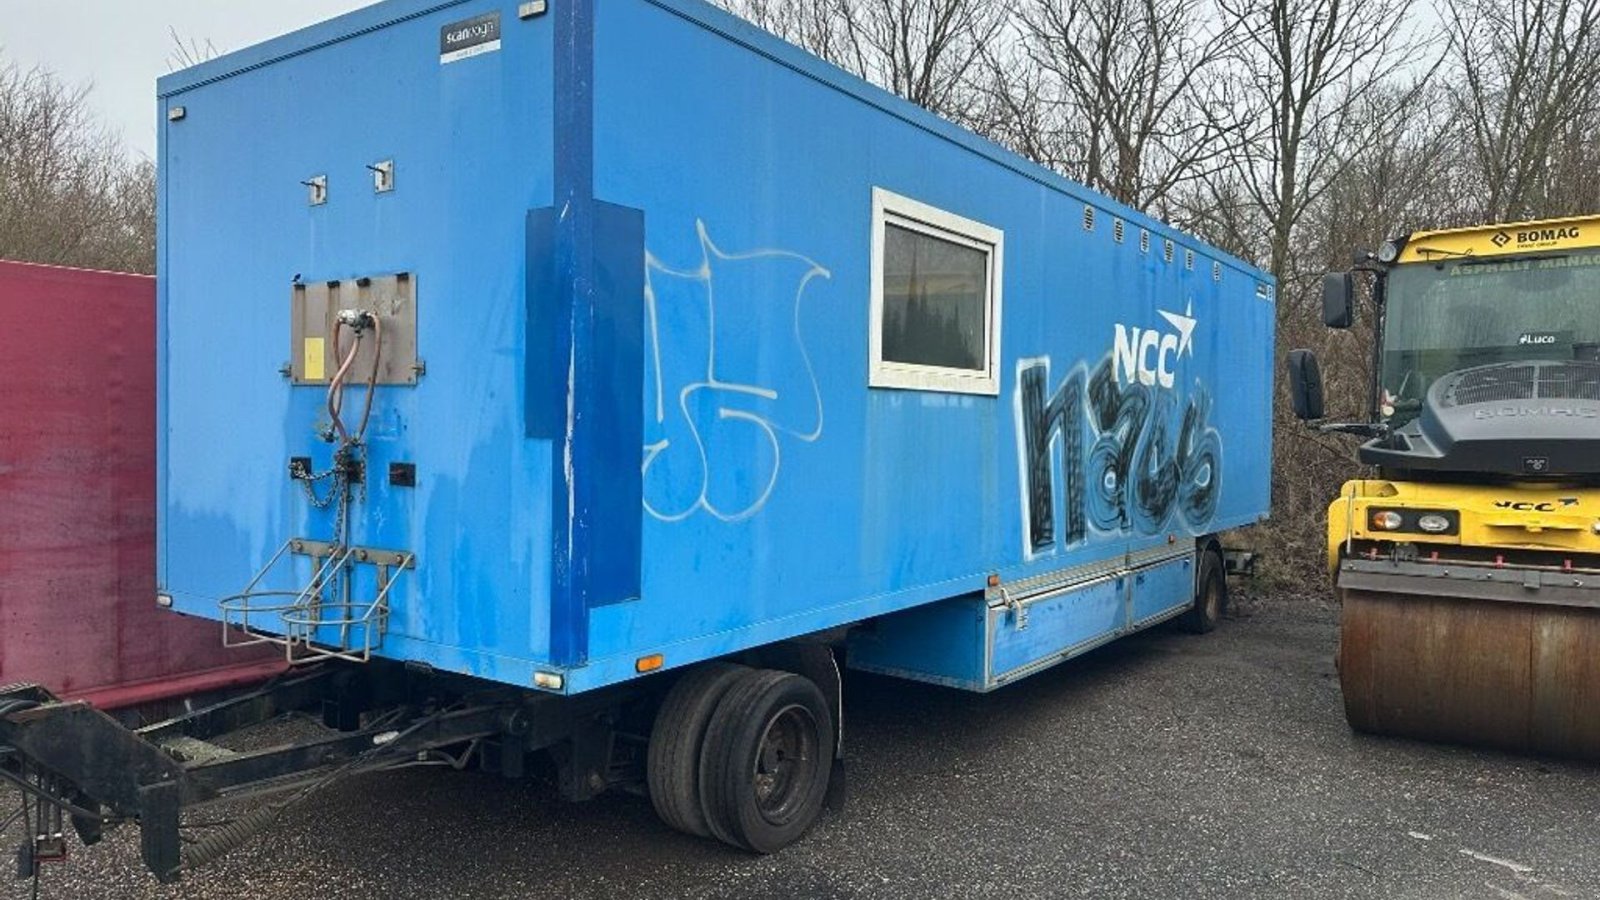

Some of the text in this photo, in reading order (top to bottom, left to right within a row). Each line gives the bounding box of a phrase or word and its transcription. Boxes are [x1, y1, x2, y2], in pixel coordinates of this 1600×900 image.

[1517, 227, 1579, 242] BOMAG
[1450, 262, 1531, 275] ASPHALT
[1113, 323, 1177, 389] NCC
